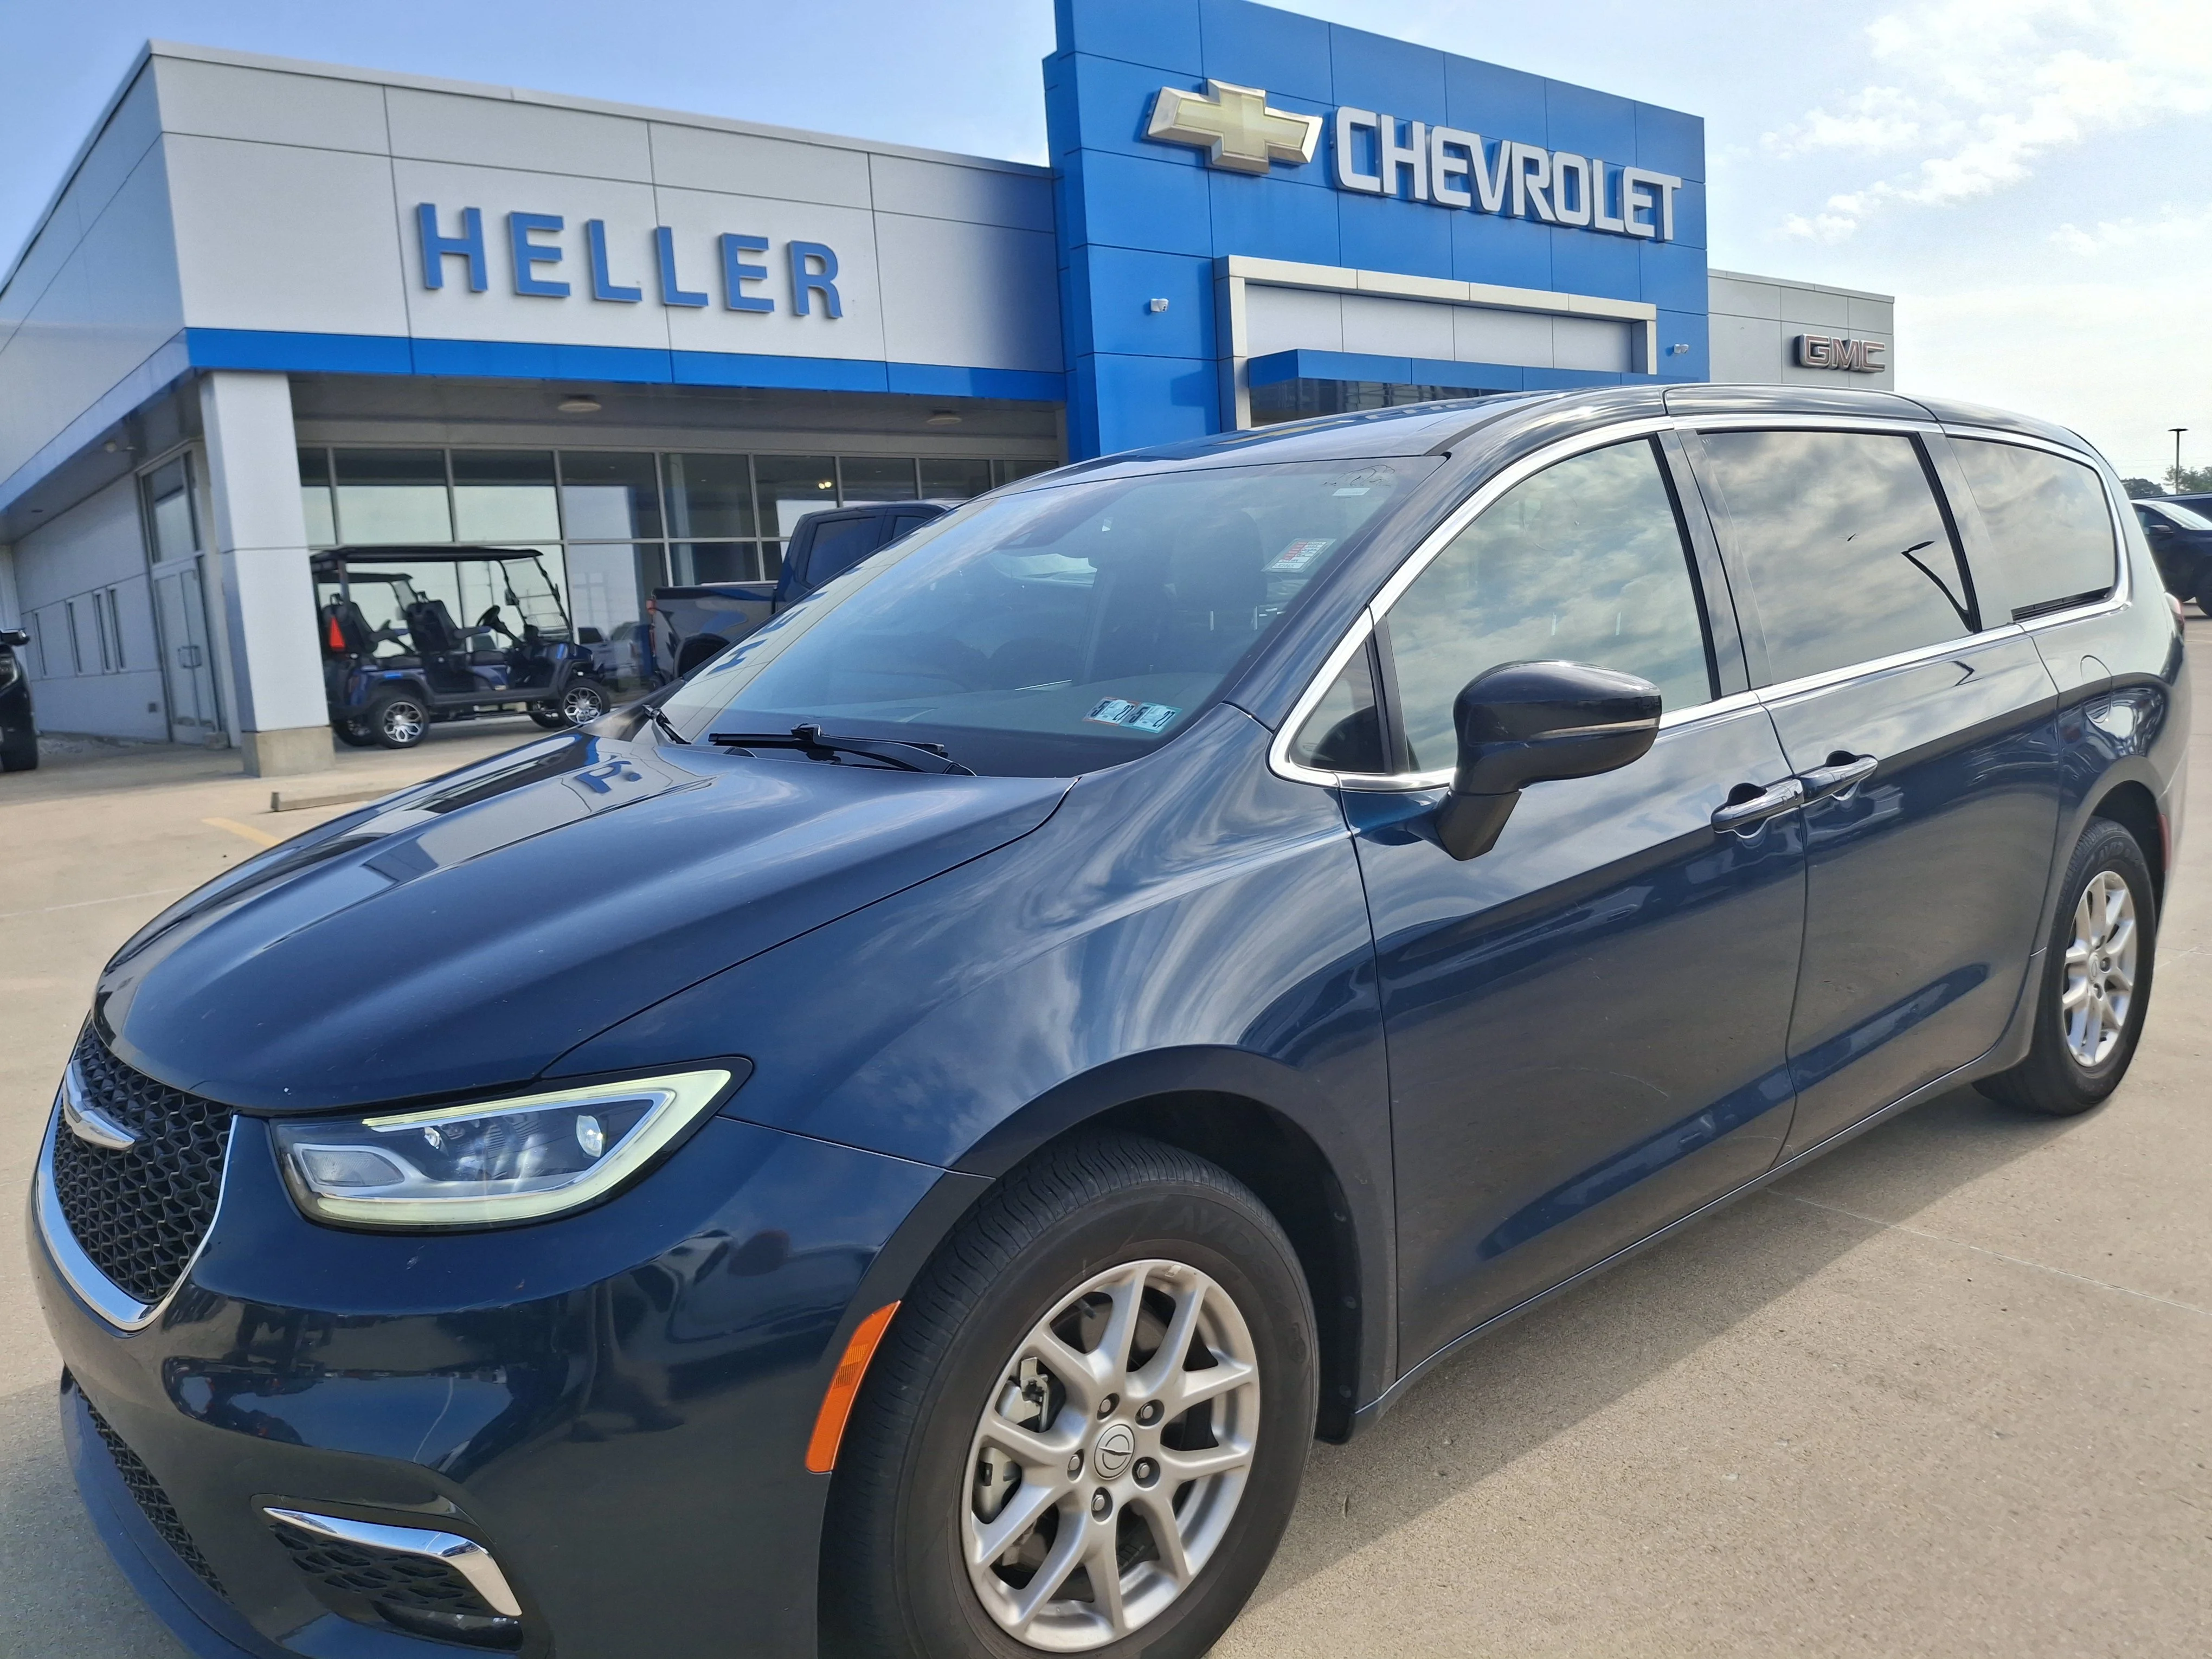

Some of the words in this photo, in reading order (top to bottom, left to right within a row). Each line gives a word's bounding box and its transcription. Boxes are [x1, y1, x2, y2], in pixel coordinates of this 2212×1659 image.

[1332, 105, 1682, 242] CHEVROLET
[416, 202, 843, 319] HELLER
[1799, 333, 1886, 372] GMC
[1091, 700, 1111, 717] 5
[1113, 705, 1134, 722] 27
[1128, 706, 1149, 723] 5
[1152, 710, 1175, 728] 27
